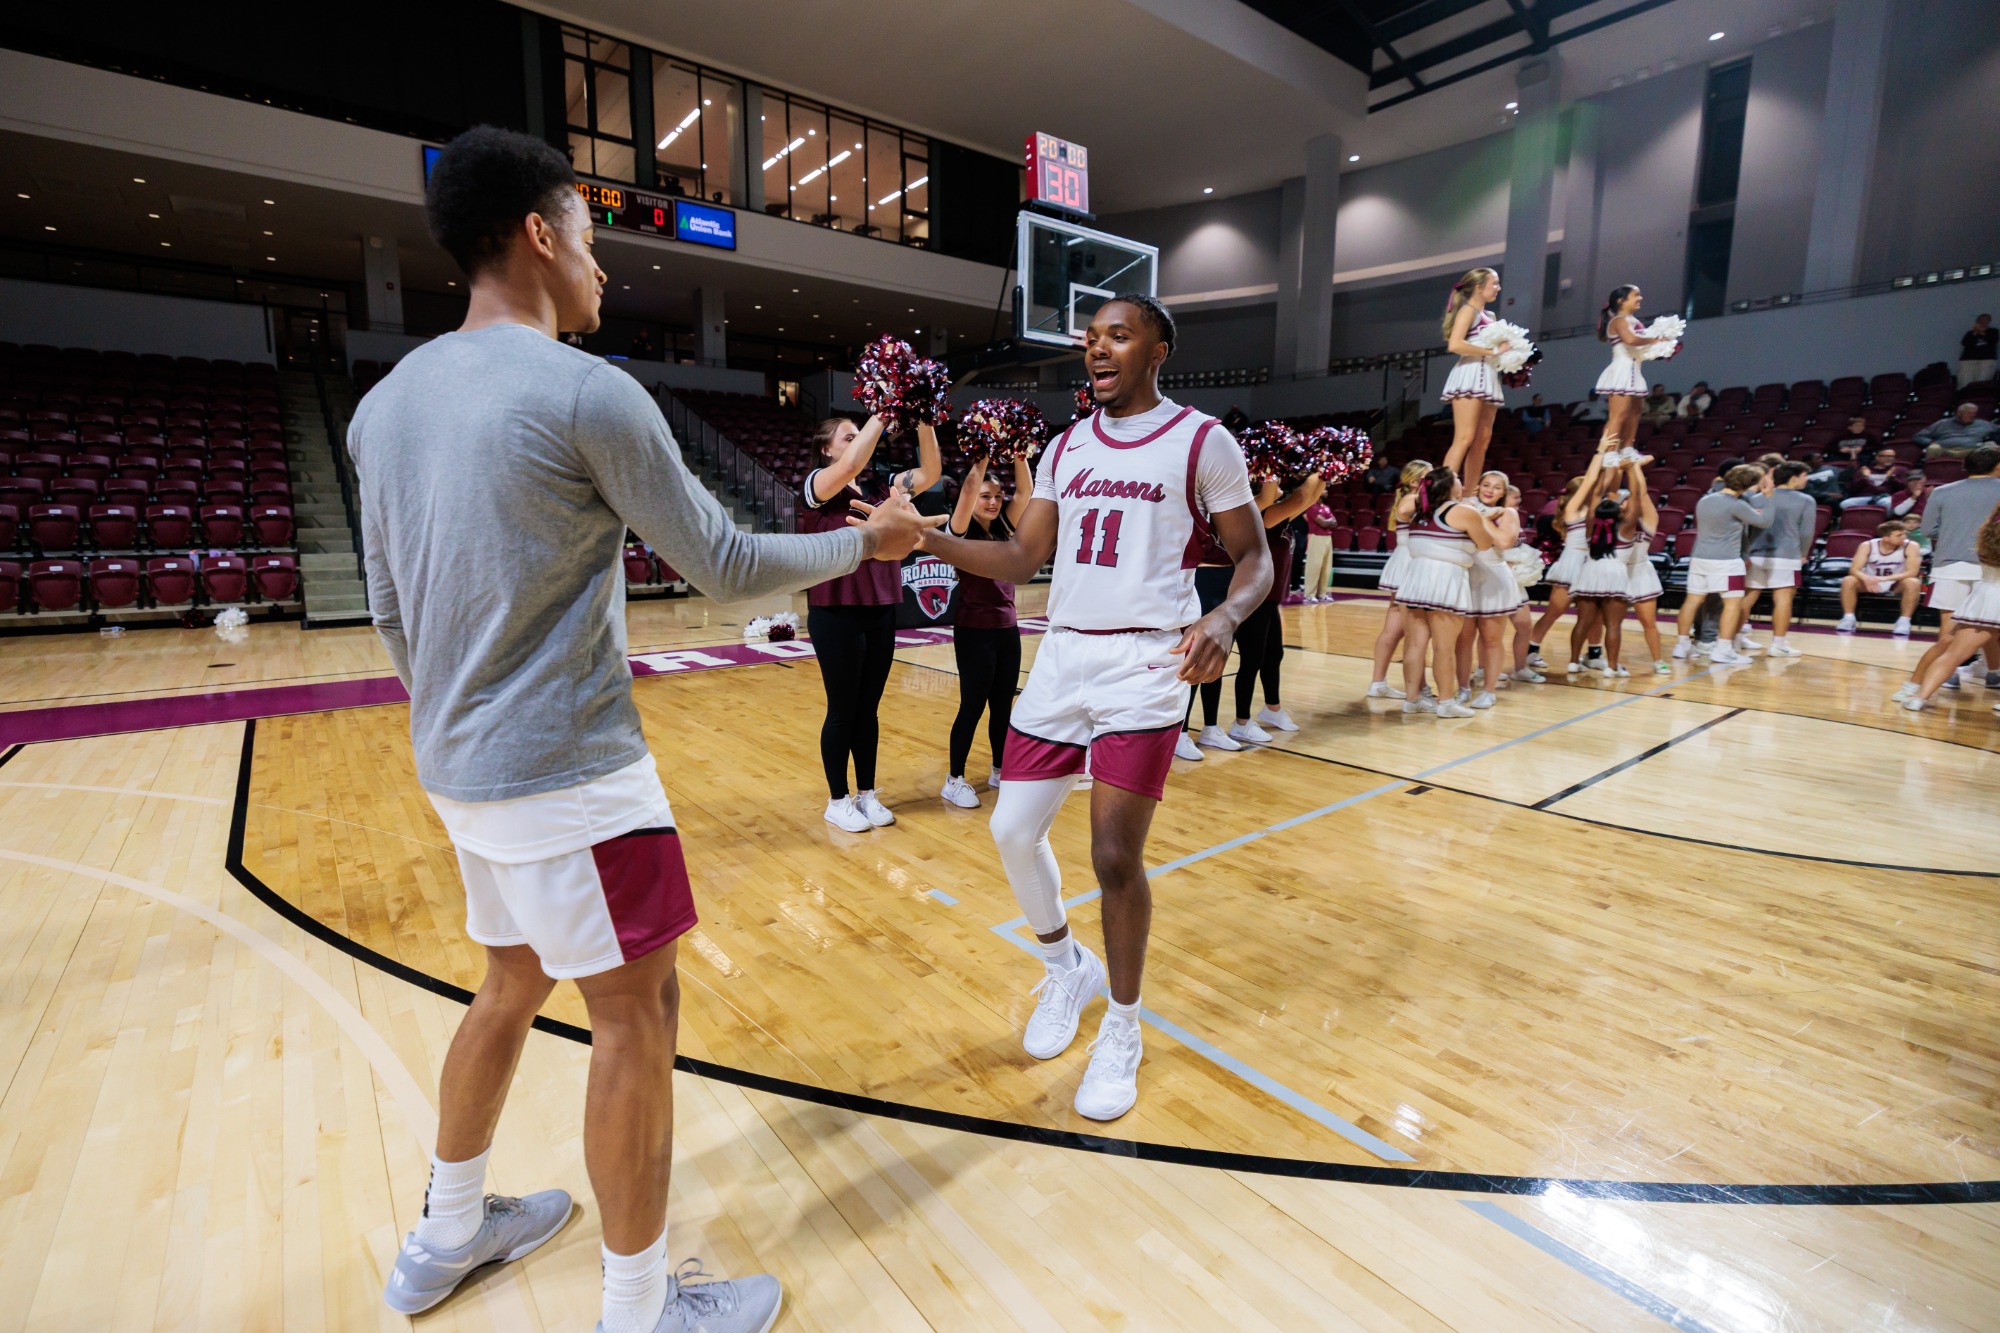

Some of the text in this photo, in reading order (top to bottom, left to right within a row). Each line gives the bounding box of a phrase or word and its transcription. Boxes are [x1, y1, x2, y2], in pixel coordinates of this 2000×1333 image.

[575, 183, 621, 207] 0:00
[1047, 164, 1080, 207] 30
[636, 194, 668, 209] VISITOR
[654, 208, 664, 225] 0
[690, 223, 733, 238] Union Bank
[1061, 468, 1166, 503] Maroons
[1076, 508, 1123, 568] 11
[903, 563, 956, 583] ROANOK
